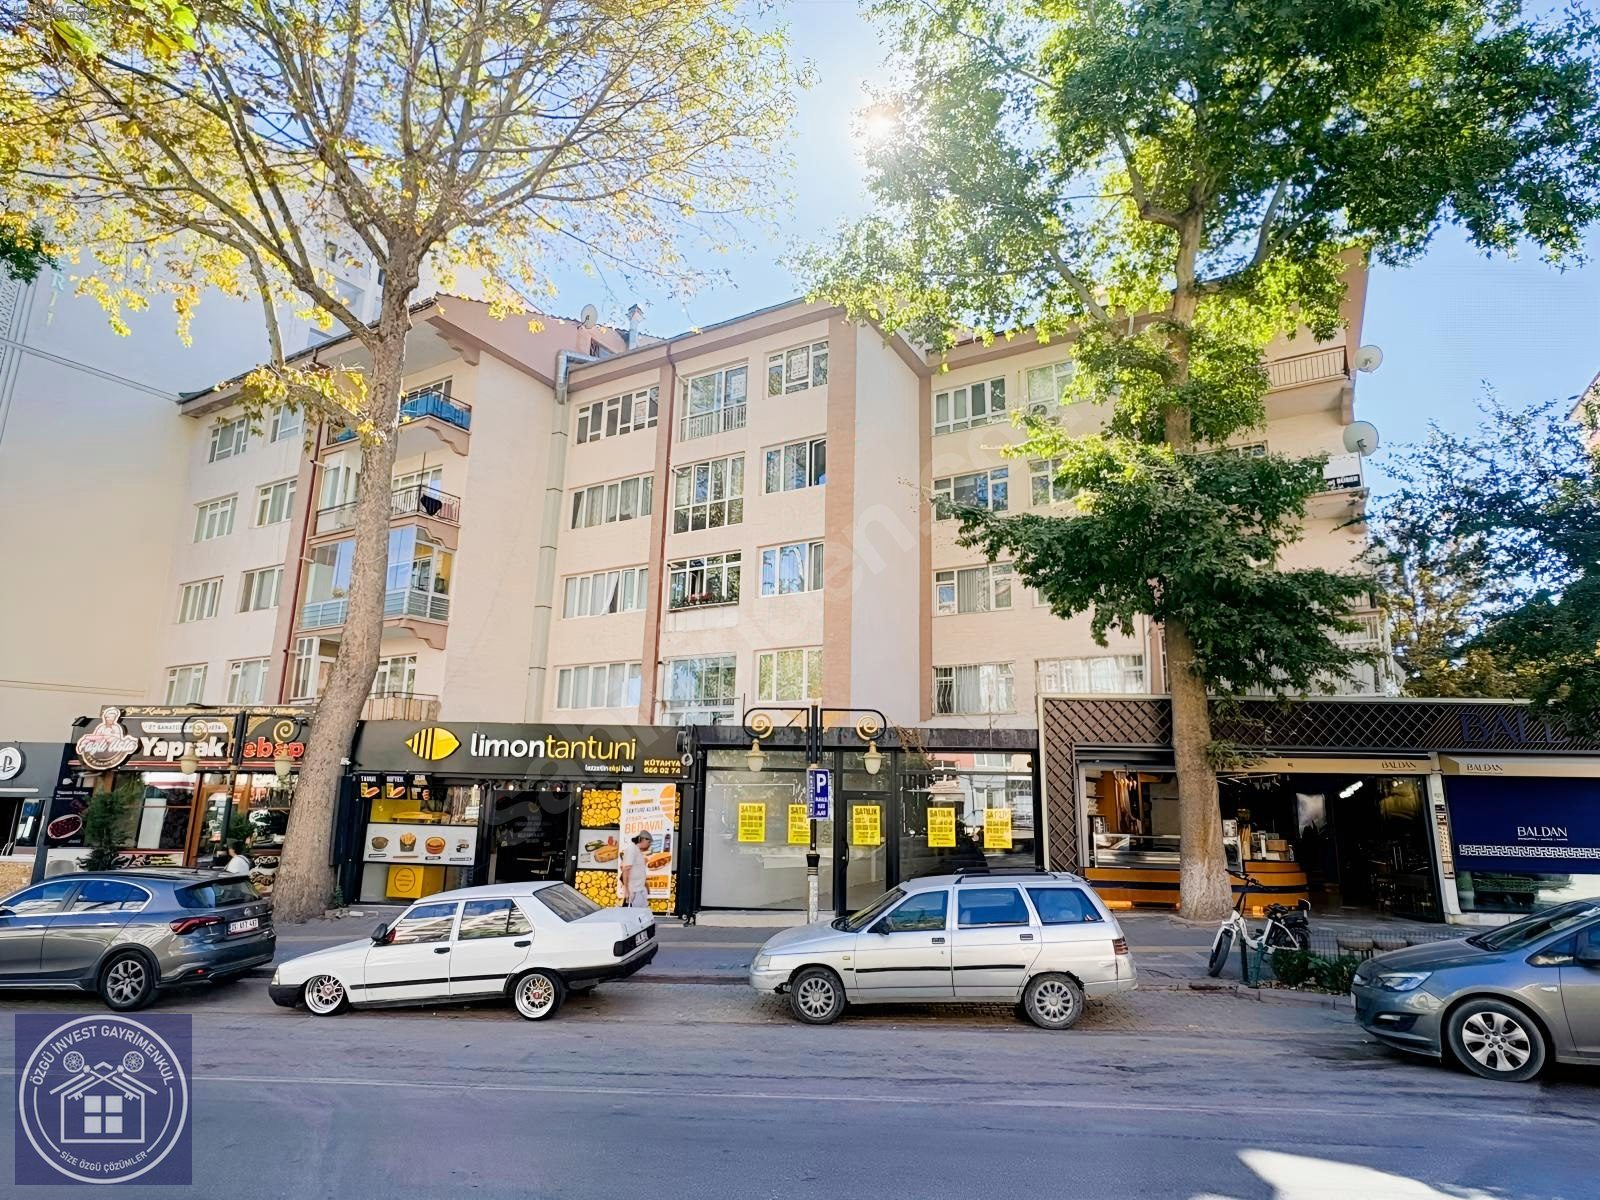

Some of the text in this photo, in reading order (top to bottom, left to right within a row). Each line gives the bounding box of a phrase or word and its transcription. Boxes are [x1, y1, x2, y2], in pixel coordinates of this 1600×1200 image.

[241, 737, 304, 757] ebap
[470, 732, 637, 760] limontantuni
[1382, 761, 1417, 769] BALDAN
[1466, 764, 1503, 772] BALDAN
[816, 773, 827, 793] P
[1517, 826, 1568, 837] BALDAN
